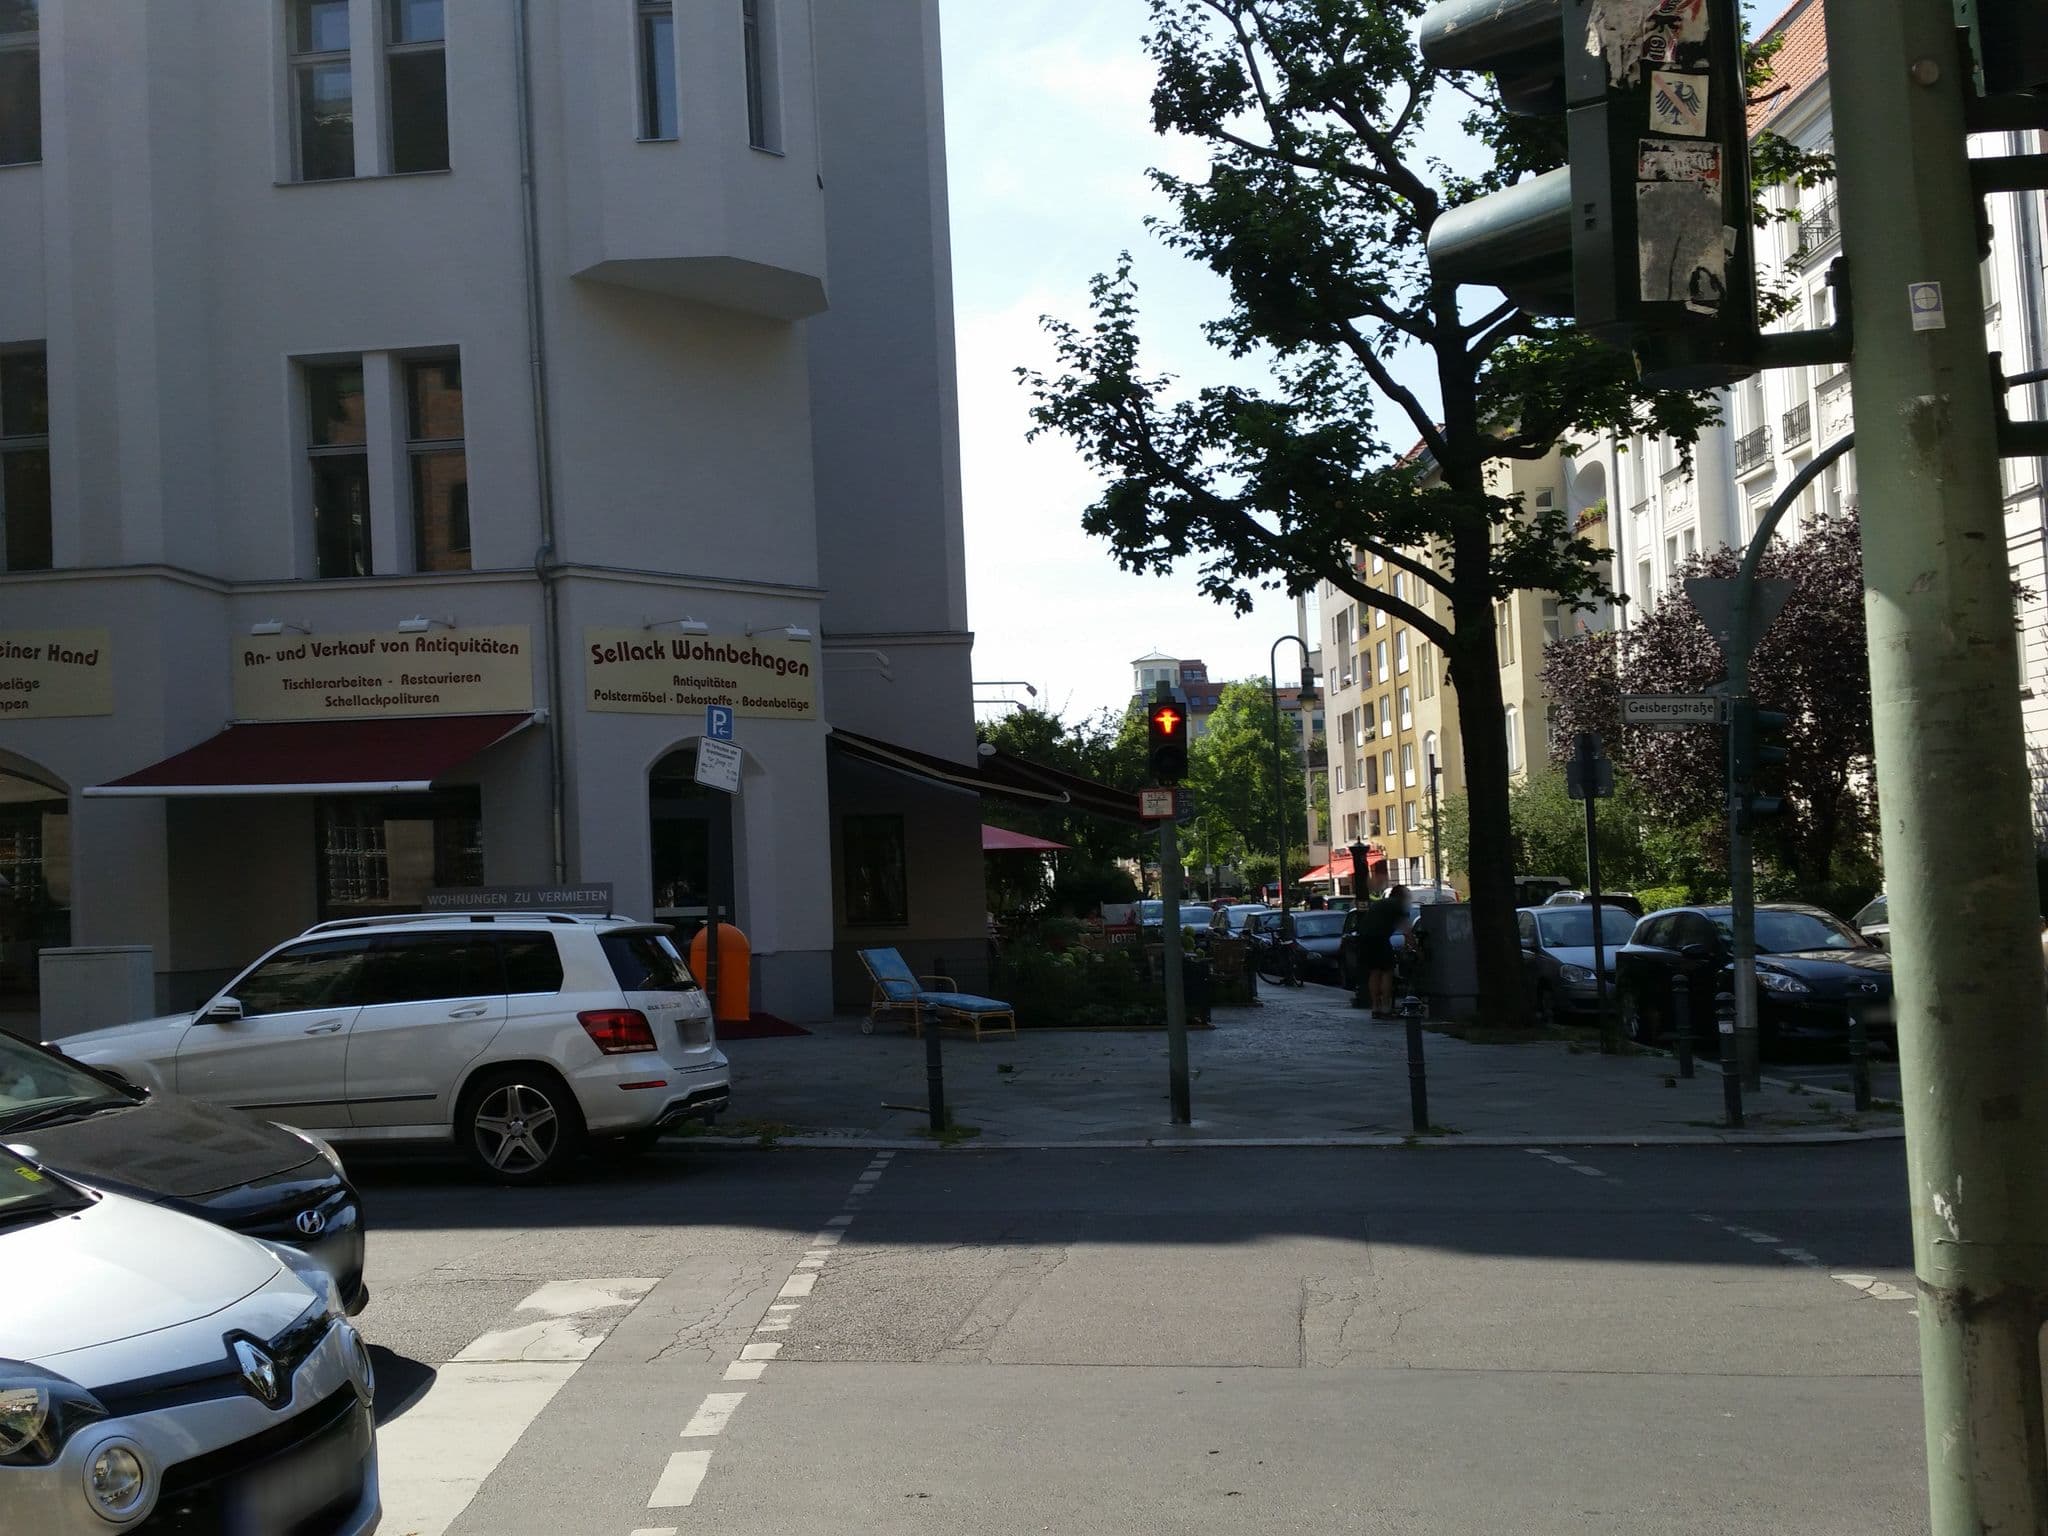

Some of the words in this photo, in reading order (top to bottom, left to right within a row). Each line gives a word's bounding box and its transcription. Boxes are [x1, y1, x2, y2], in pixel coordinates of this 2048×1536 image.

[47, 644, 99, 666] Hand
[244, 651, 271, 667] An-
[276, 644, 306, 662] und
[311, 639, 375, 657] Verkauf
[381, 641, 409, 653] von
[415, 637, 519, 656] Antiquitäten
[591, 640, 666, 665] Sellack
[672, 640, 809, 678] Wohnbehagen
[282, 676, 382, 690] Tischlerarbeiten
[401, 672, 481, 685] Restaurieren
[673, 675, 737, 690] Antiquitäten
[325, 692, 440, 708] Schellackpolituren
[594, 689, 666, 704] Polstermöbel
[677, 693, 733, 706] Dekostoffe
[742, 696, 809, 711] Bodenbeläge
[1628, 701, 1714, 716] Geisbergstraße
[712, 709, 726, 735] P
[427, 893, 508, 906] WOHNUNGEN
[514, 891, 531, 904] ZU
[538, 889, 608, 903] VERMIETEN
